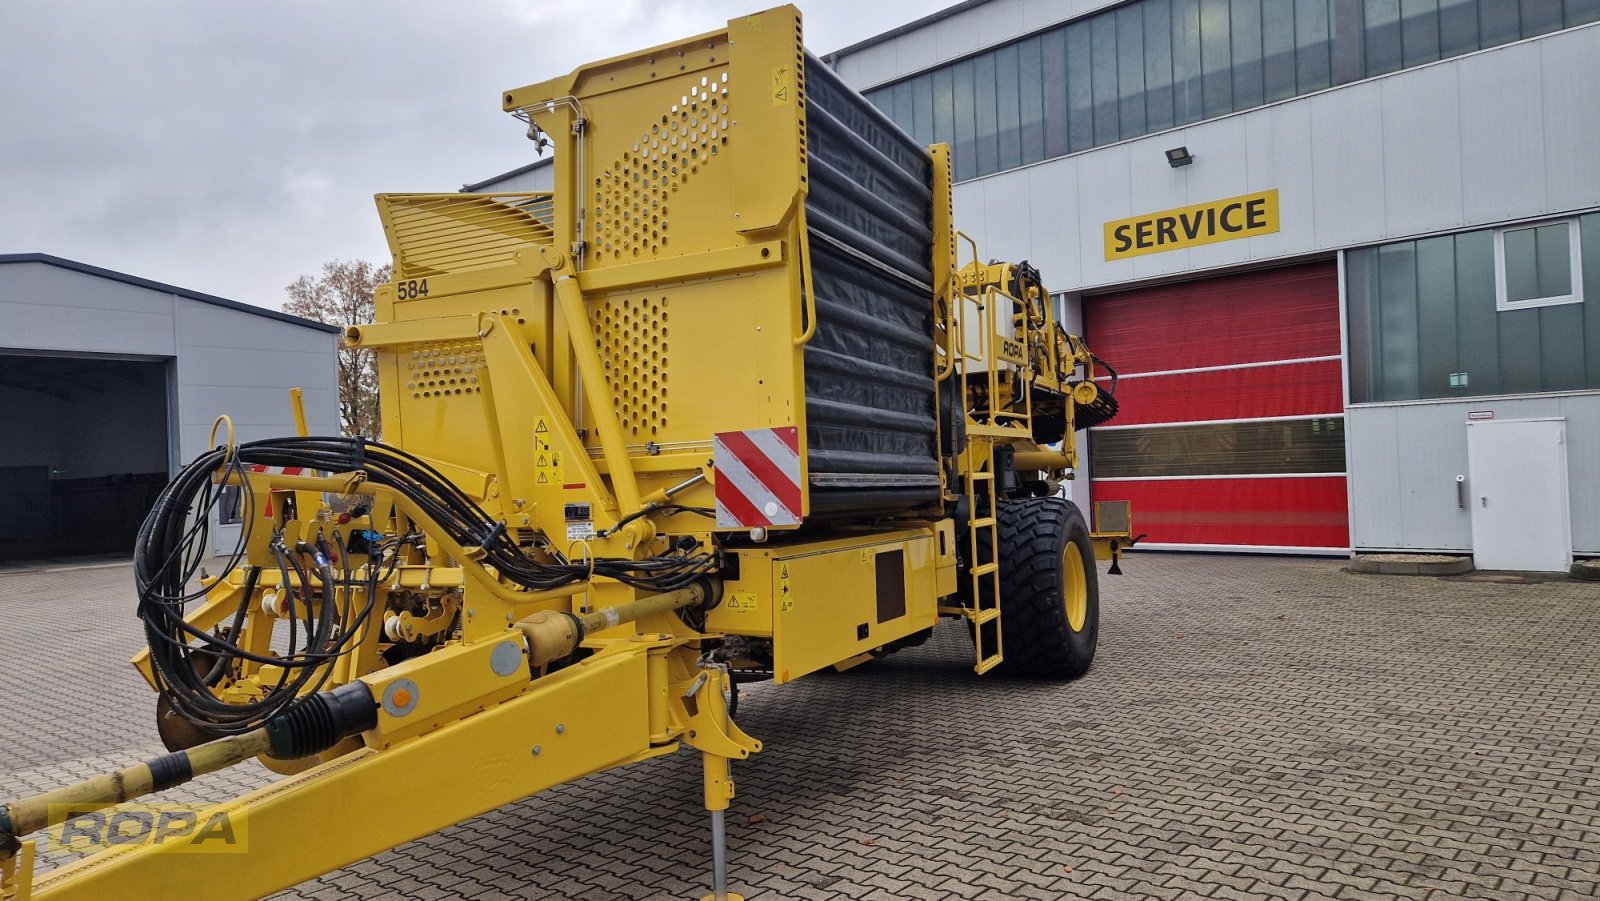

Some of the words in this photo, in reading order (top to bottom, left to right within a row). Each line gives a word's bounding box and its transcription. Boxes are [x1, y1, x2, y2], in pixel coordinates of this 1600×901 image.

[1114, 198, 1266, 252] SERVICE
[398, 279, 428, 300] 584
[1003, 340, 1023, 360] ROPA
